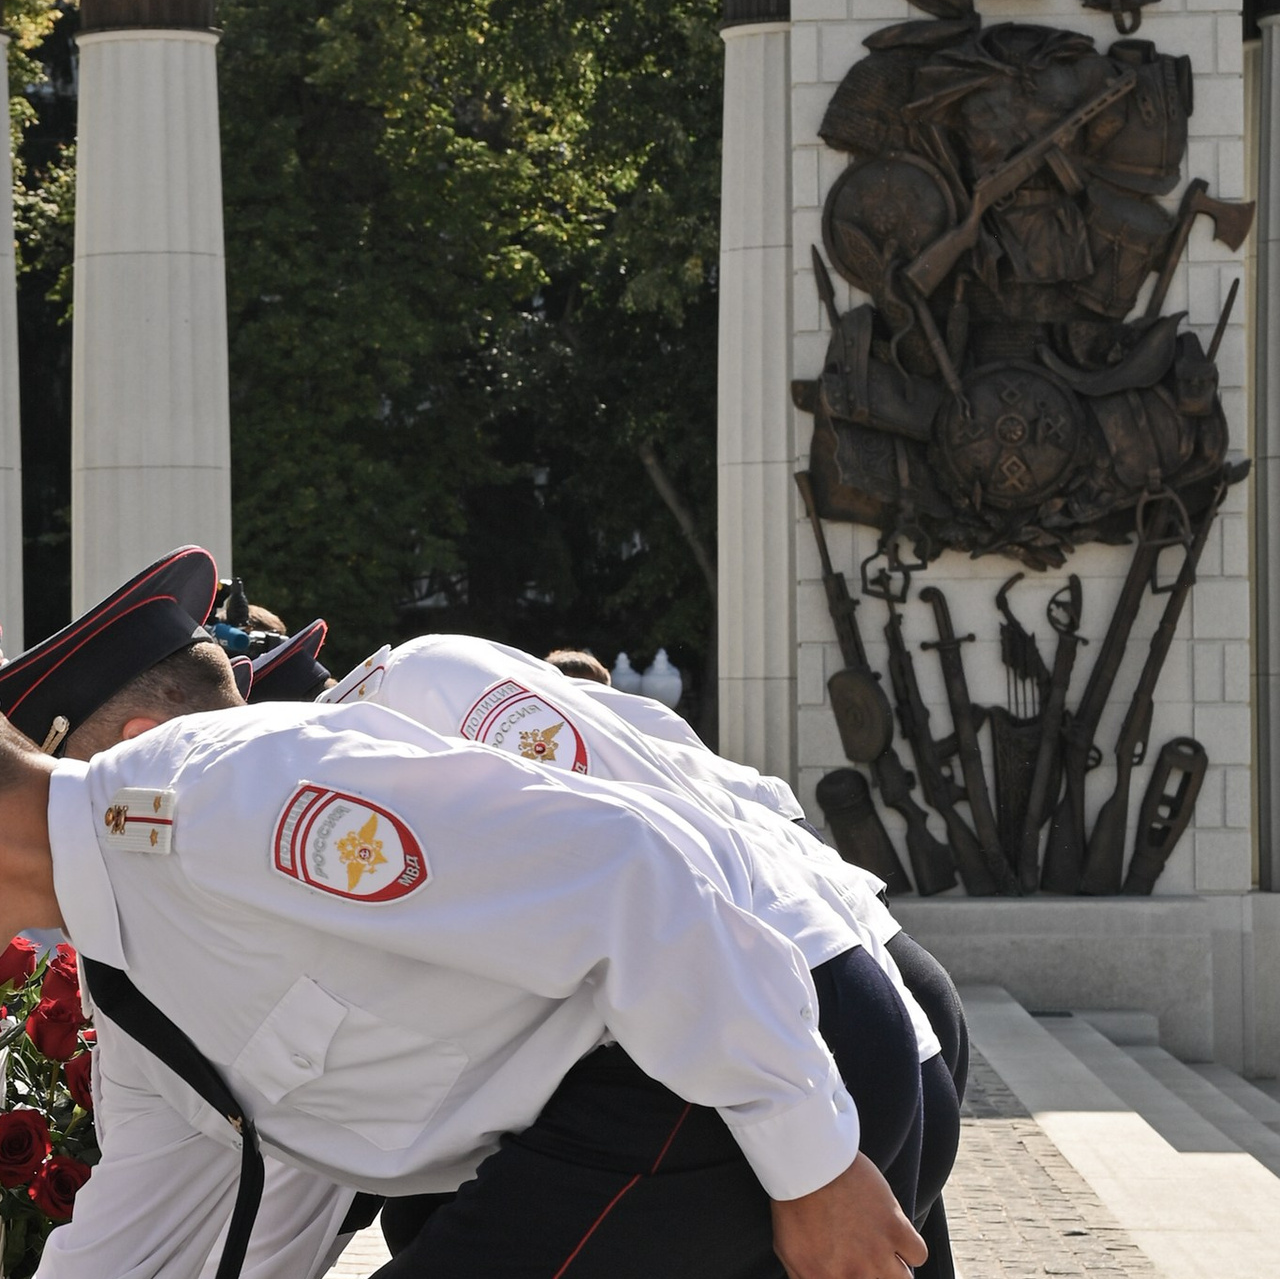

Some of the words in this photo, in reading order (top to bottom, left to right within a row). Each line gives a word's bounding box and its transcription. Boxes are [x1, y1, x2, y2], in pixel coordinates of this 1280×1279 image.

[466, 683, 519, 737] ПОЛИЦИЯ
[280, 791, 318, 869] ПОЛИЦИЯ
[312, 805, 352, 880] РОССИЯ
[398, 854, 421, 887] МВД
